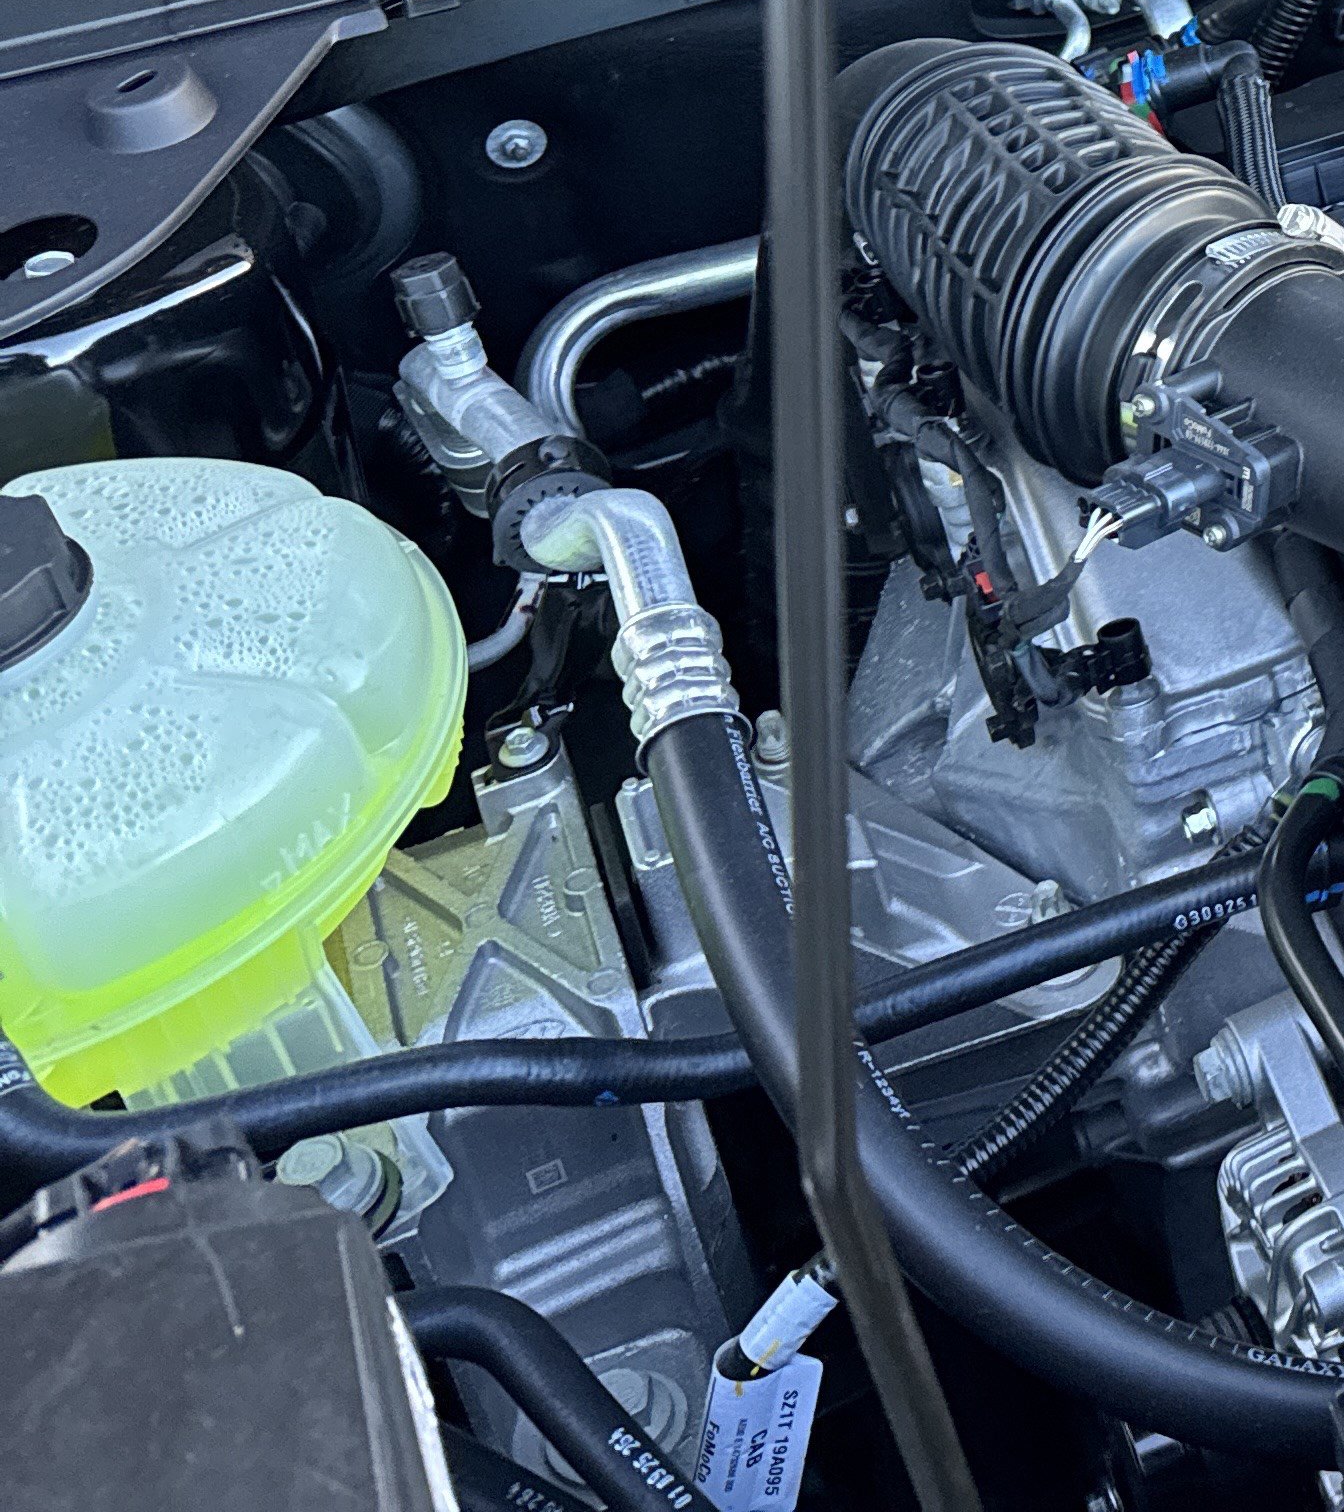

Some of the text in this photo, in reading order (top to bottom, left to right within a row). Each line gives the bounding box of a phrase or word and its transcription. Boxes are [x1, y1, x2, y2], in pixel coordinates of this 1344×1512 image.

[756, 821, 776, 850] A/C
[767, 853, 795, 915] SUCTIO
[698, 1420, 720, 1483] FoMoCo
[746, 1429, 768, 1469] CAB
[764, 1390, 799, 1496] SZ1T 19A095
